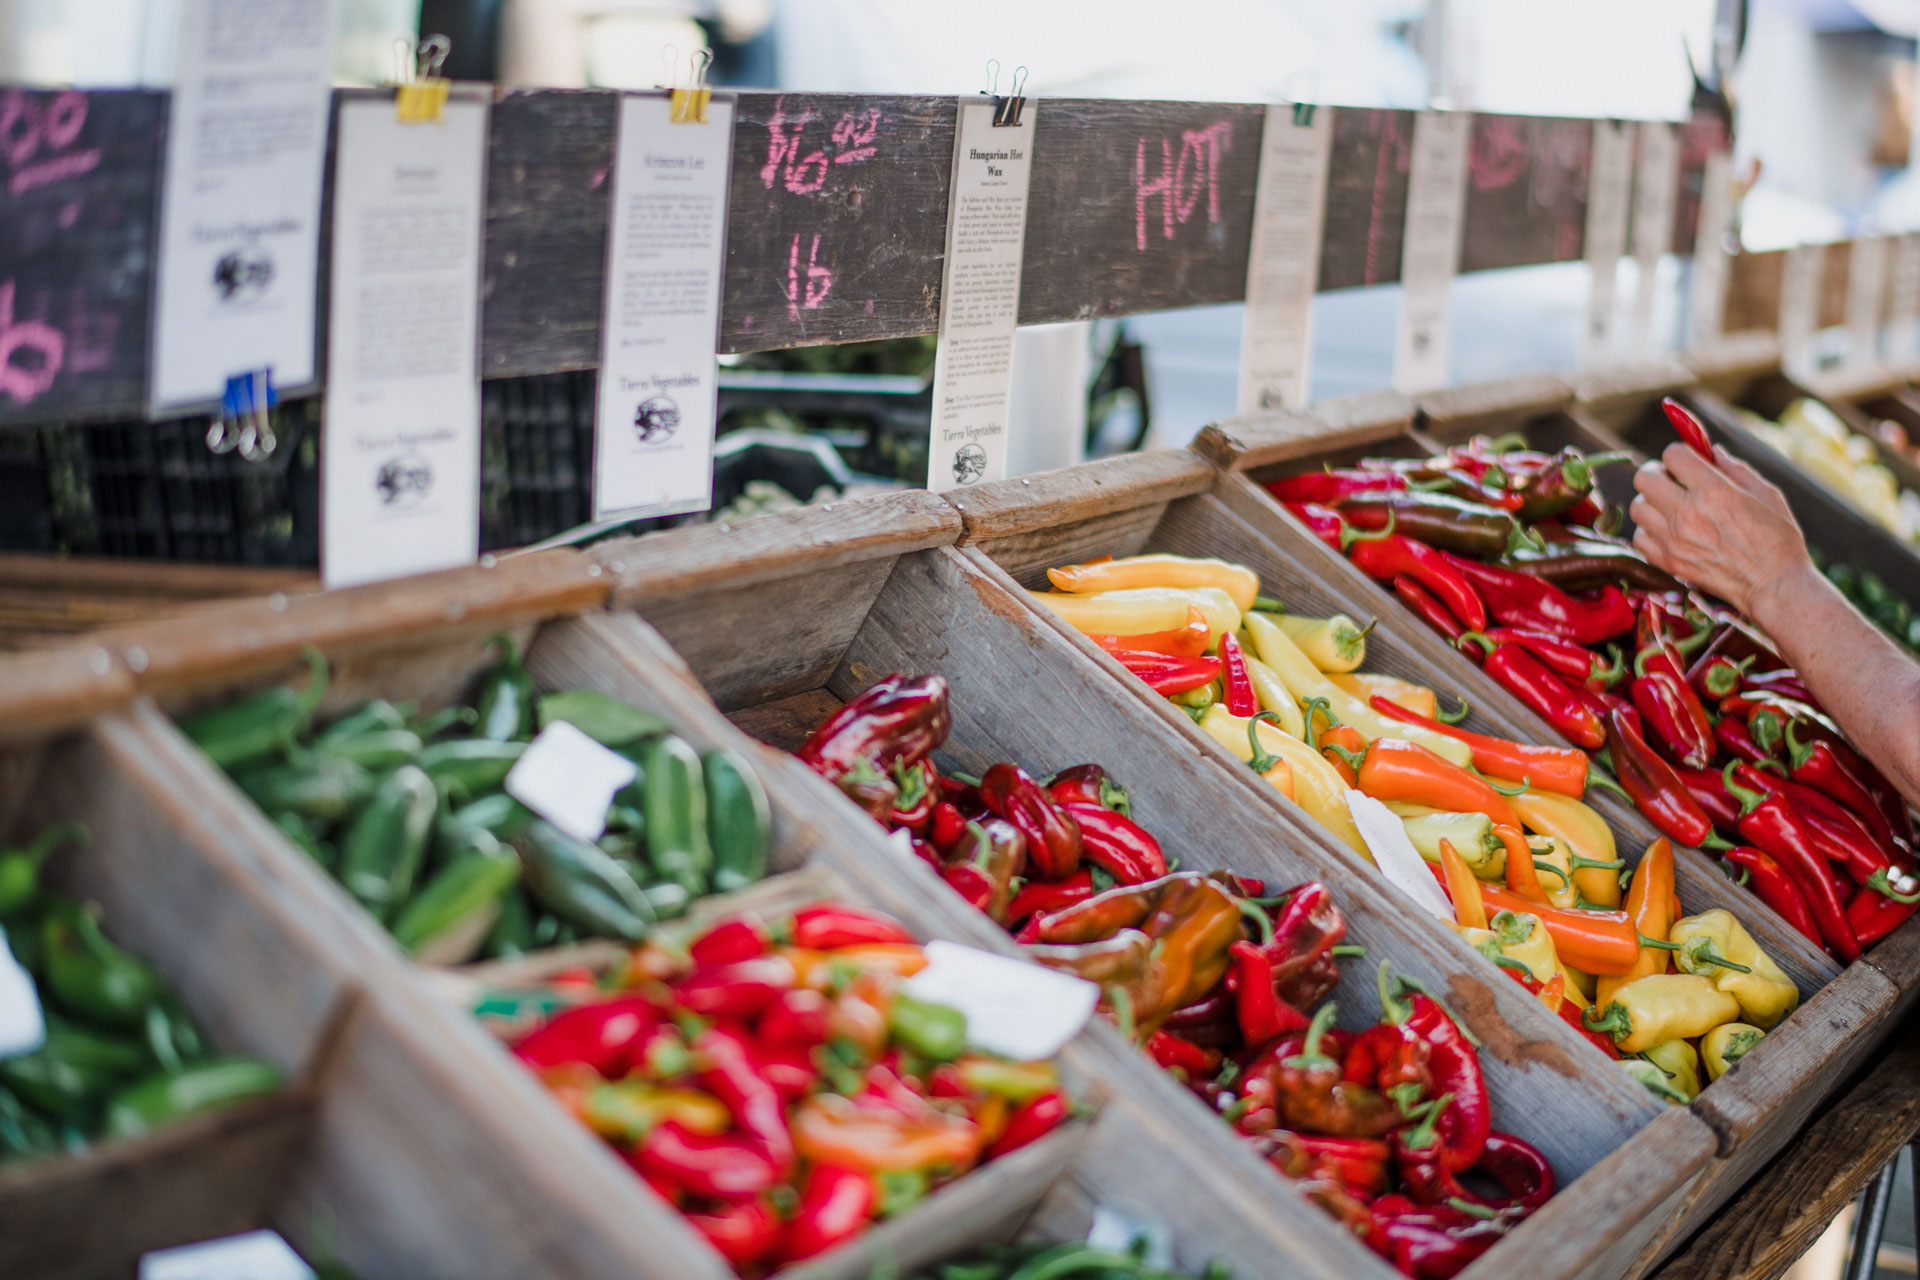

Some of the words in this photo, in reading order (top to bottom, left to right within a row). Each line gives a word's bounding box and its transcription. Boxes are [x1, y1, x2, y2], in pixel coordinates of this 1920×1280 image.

[969, 148, 1008, 163] Hungarian
[1009, 149, 1023, 161] Hot
[988, 165, 1003, 177] Wax
[1136, 121, 1232, 253] HOT
[943, 428, 965, 442] Tierra
[965, 422, 1002, 443] Vegetables
